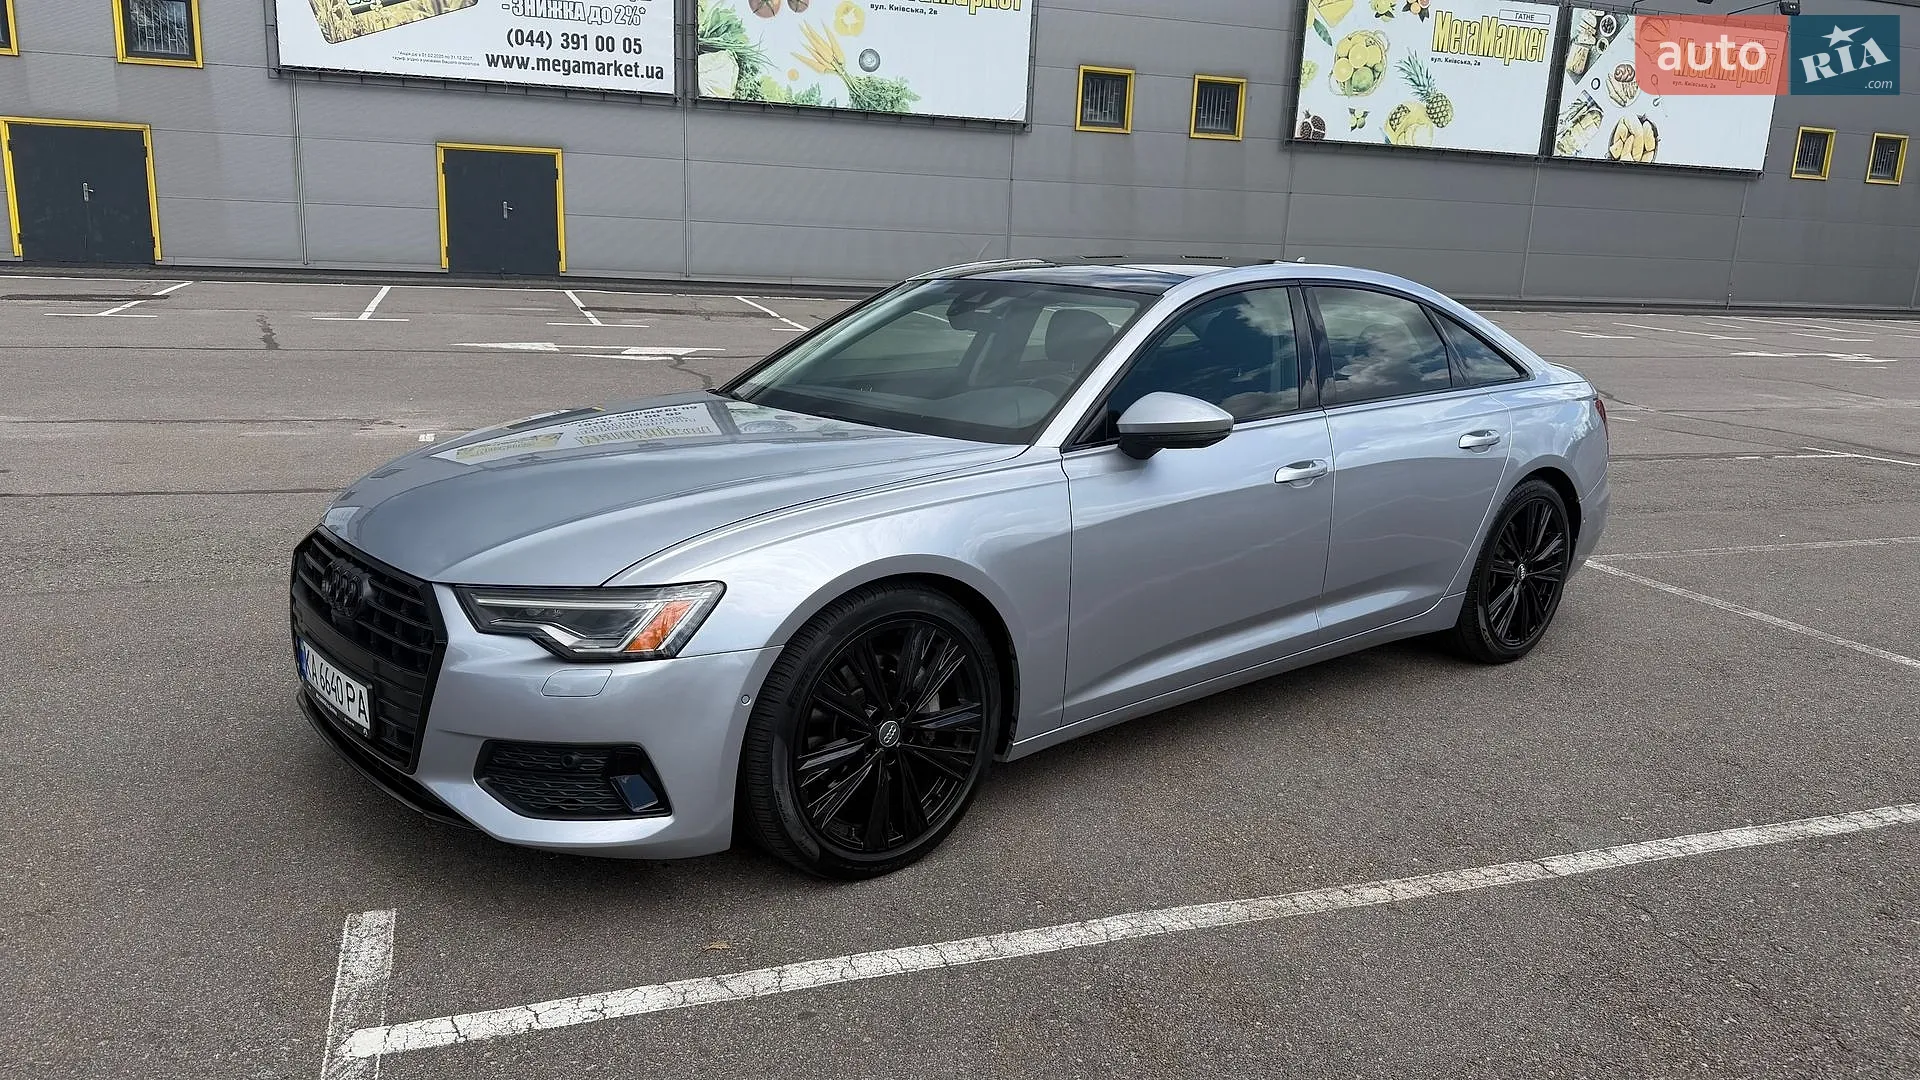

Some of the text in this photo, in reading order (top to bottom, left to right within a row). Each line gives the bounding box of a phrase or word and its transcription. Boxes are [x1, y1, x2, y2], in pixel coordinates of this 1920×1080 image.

[512, 0, 586, 21] ЗНИЖКА
[587, 6, 613, 25] до
[870, 3, 887, 11] вул.
[889, 5, 927, 15] Київська,
[1515, 12, 1535, 21] ГАТНЕ
[506, 28, 643, 55] (044) 391 00 05
[1432, 10, 1549, 67] МегаМаркет
[485, 53, 664, 80] www.megamarket.ua
[304, 645, 319, 686] KA
[319, 662, 344, 706] 6640
[345, 681, 369, 724] PA
